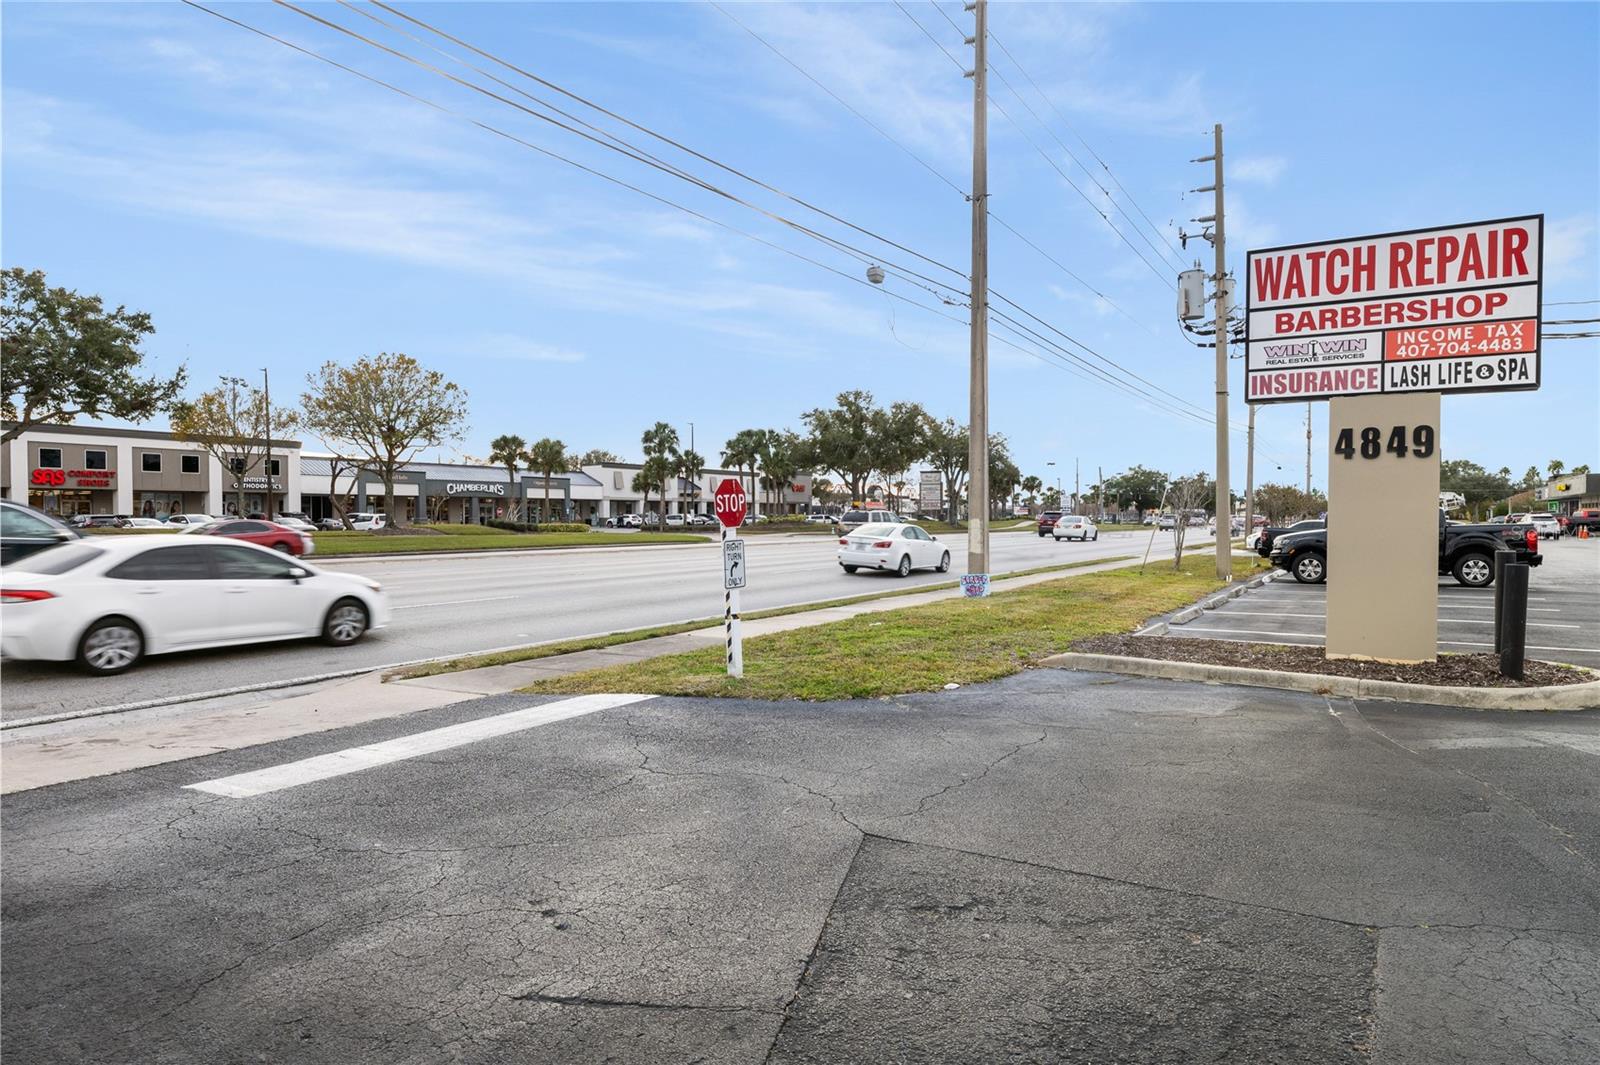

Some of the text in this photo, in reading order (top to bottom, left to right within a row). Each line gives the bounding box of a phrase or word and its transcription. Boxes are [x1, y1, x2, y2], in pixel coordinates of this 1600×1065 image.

[1254, 227, 1529, 302] WATCH REPAIR
[1275, 292, 1508, 334] BARBERSHOP
[1397, 322, 1523, 345] INCOME TAX
[1264, 338, 1367, 358] WIN WIN
[1396, 337, 1523, 358] 407-704-4483
[1288, 356, 1319, 364] ESTATE
[1322, 352, 1365, 362] SERVICES
[1251, 367, 1379, 396] INSURANCE
[1390, 358, 1529, 388] LASH LIFE & SPA
[1335, 424, 1434, 460] 4849
[446, 483, 504, 496] CHAMBERLIN'S
[716, 494, 745, 512] STOP
[726, 543, 742, 552] RIGHT
[727, 552, 742, 560] TURN
[728, 577, 743, 587] ONLY
